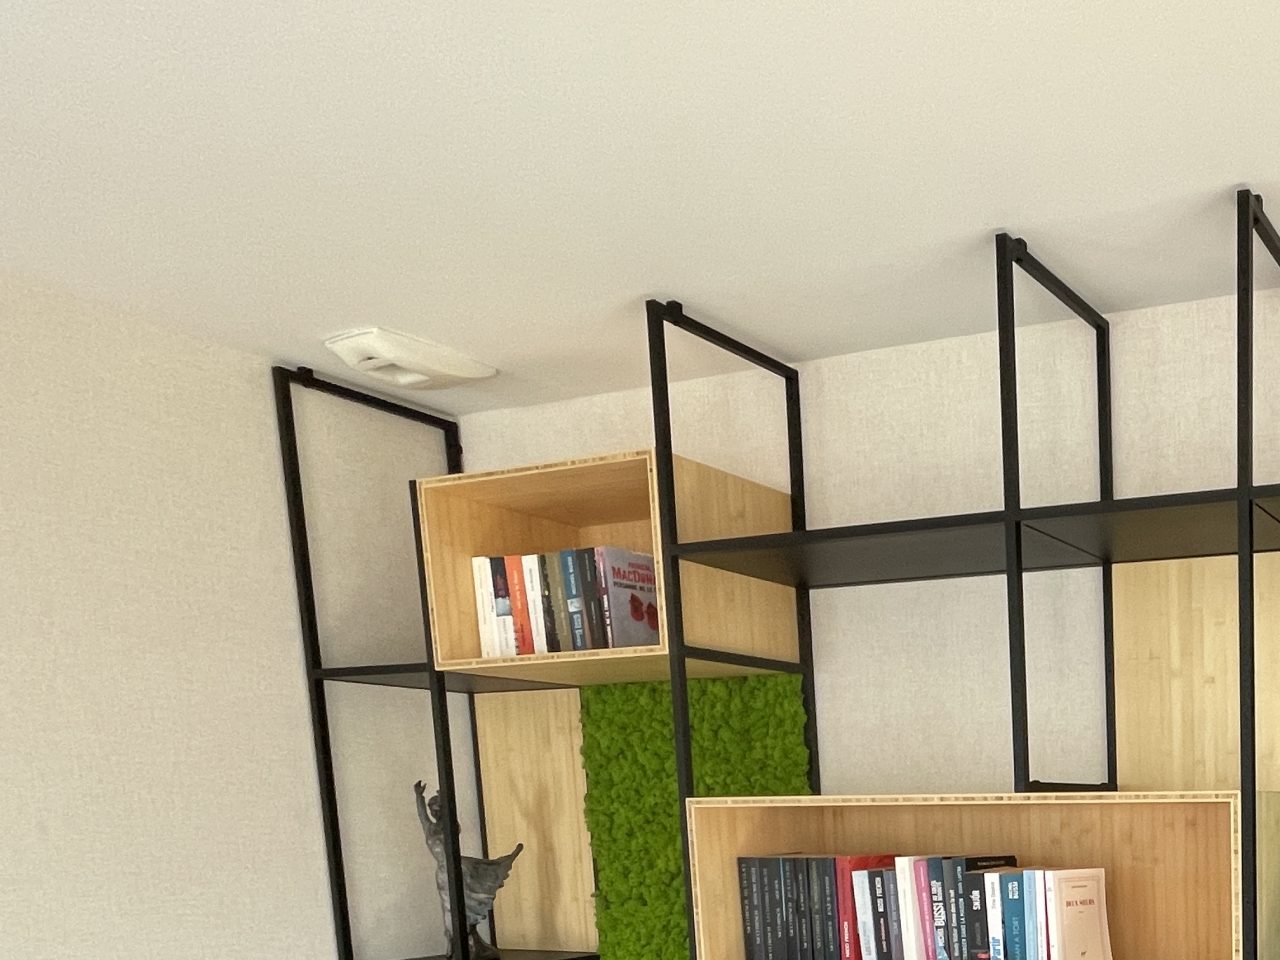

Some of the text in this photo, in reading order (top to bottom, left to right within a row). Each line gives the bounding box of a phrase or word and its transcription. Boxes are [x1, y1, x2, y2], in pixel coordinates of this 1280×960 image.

[932, 902, 945, 926] BUSSI
[1012, 917, 1020, 935] TORT
[990, 937, 1001, 960] Partir
